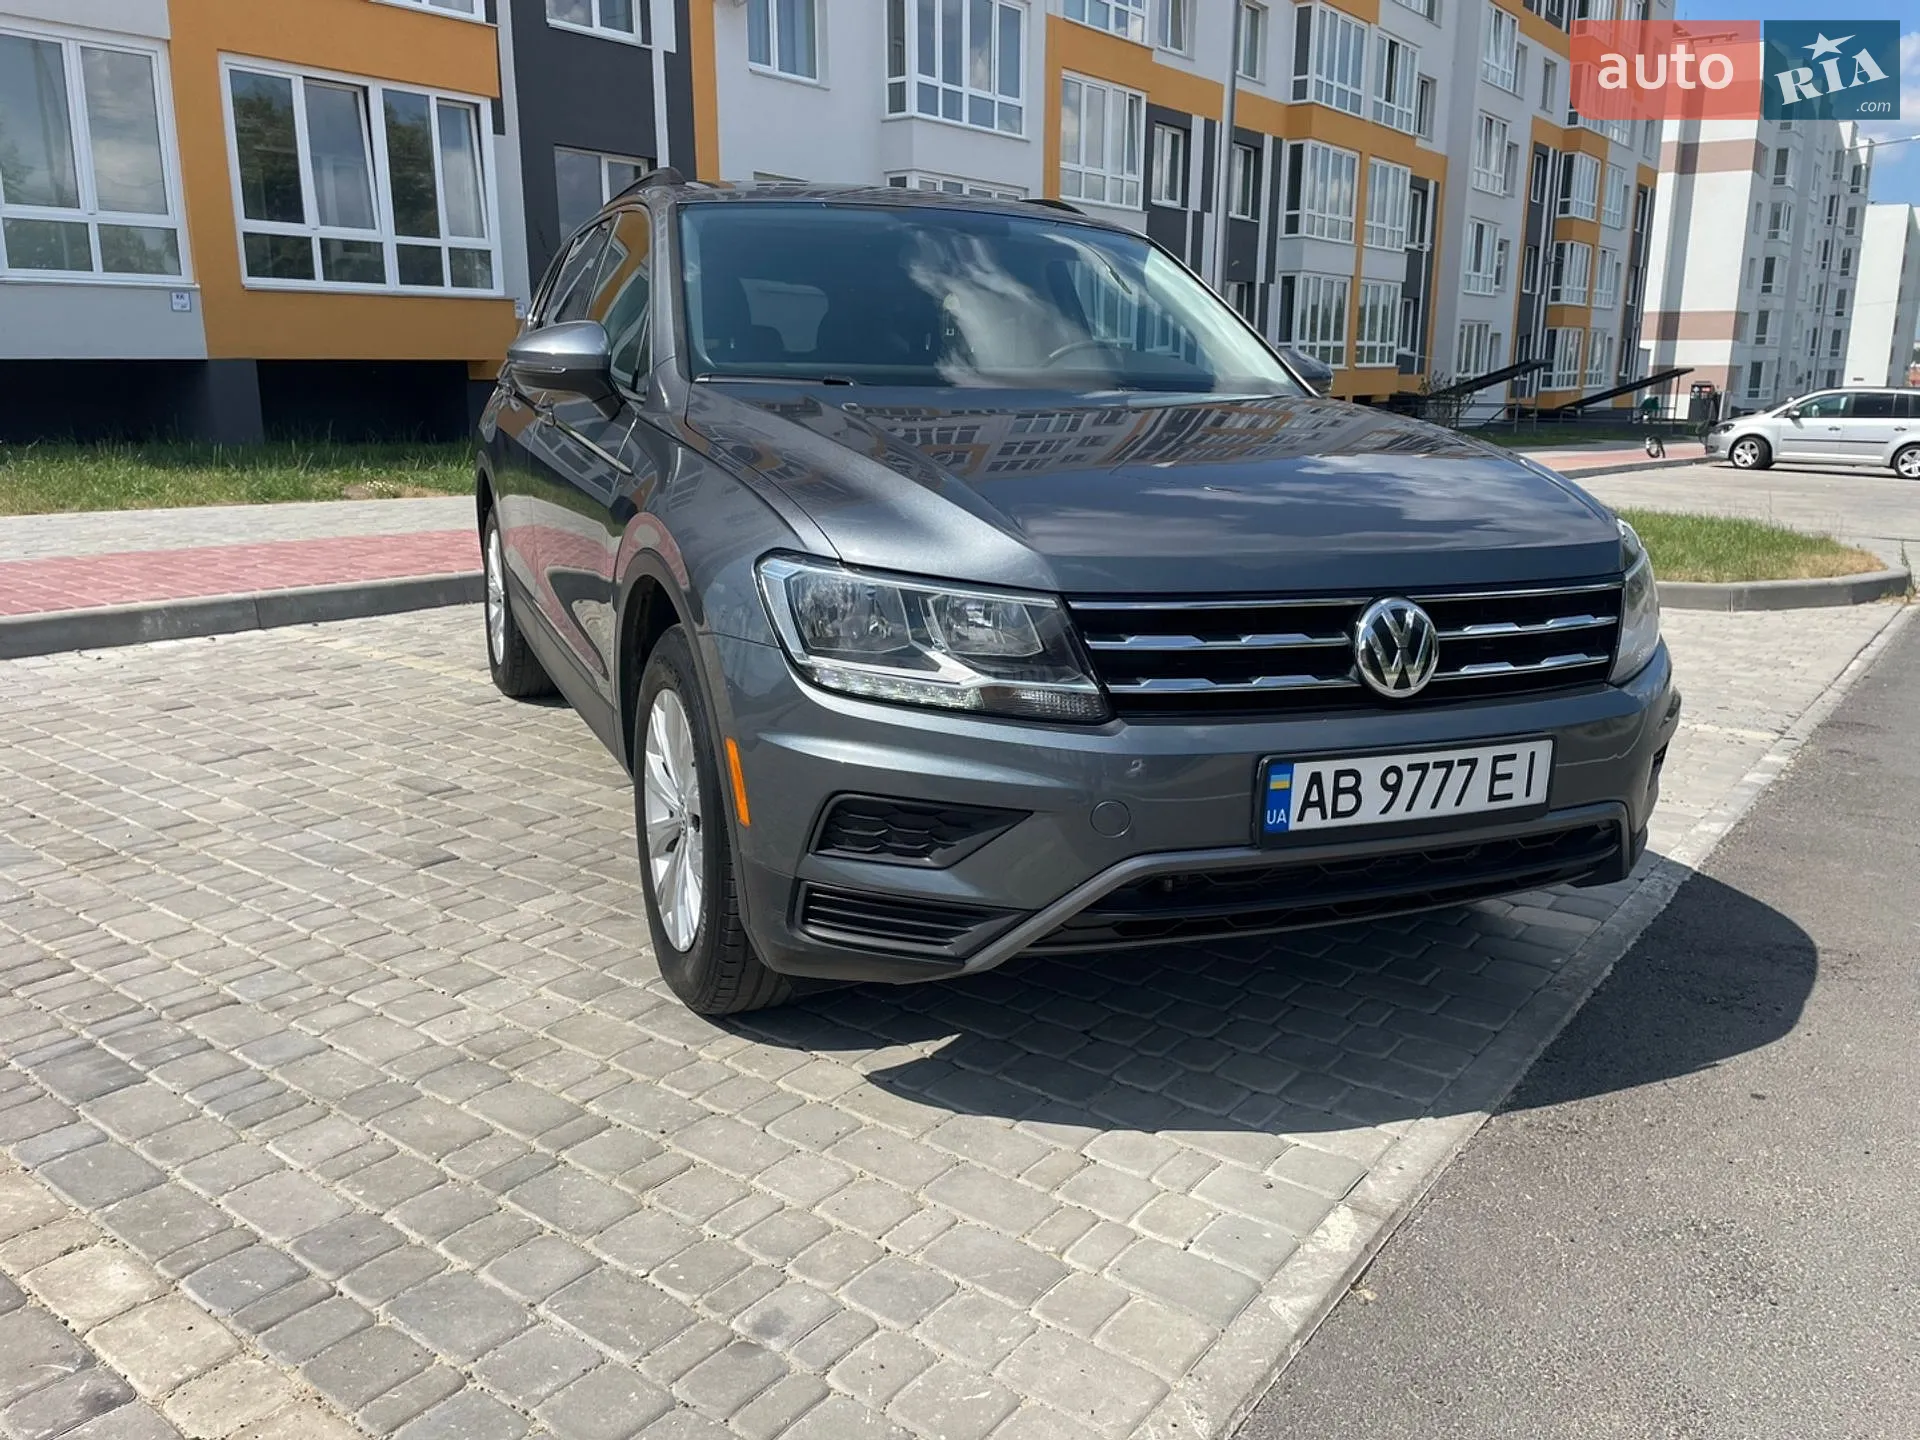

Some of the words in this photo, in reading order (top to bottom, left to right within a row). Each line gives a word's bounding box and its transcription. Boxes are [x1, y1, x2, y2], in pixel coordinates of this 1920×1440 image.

[1296, 767, 1363, 823] AB
[1378, 757, 1479, 816] 9777
[1487, 751, 1537, 803] EI
[1266, 808, 1288, 825] UA
